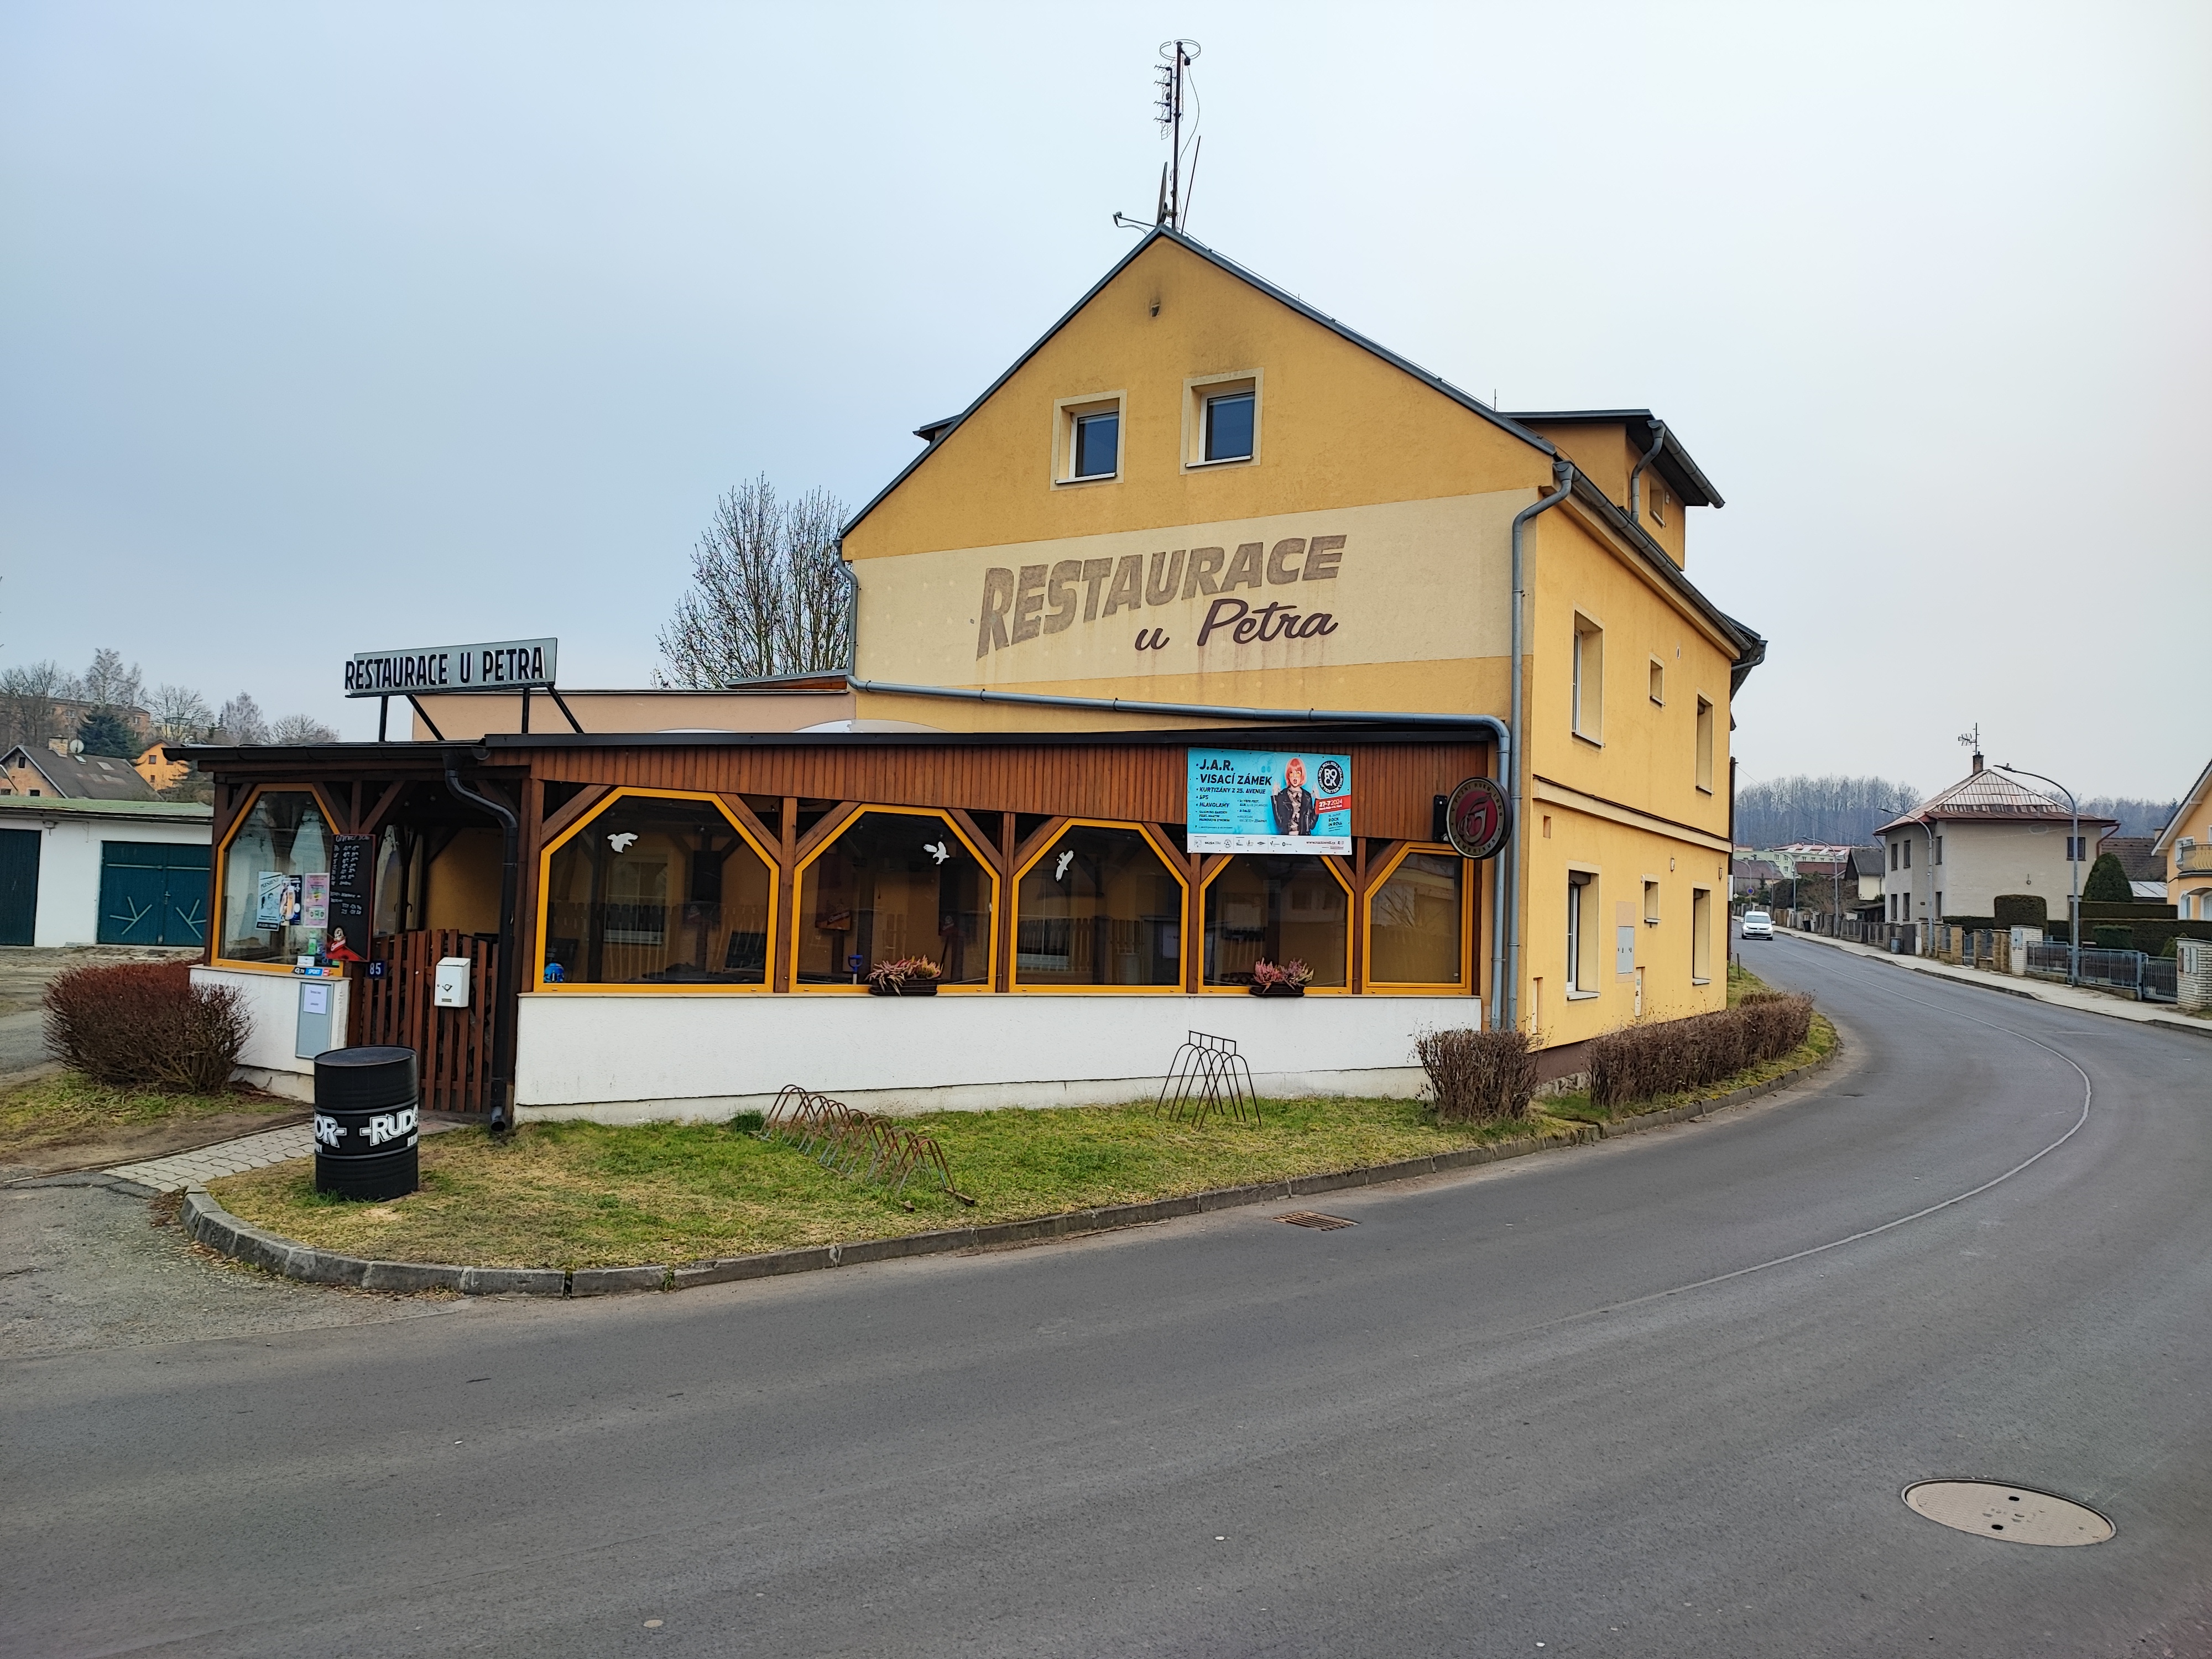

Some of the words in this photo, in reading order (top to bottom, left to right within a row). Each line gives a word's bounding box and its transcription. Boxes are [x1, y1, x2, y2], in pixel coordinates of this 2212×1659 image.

[977, 534, 1347, 661] RESTAURACE
[1134, 627, 1170, 651] u
[1197, 598, 1339, 646] Petra
[345, 654, 450, 690] RESTAURACE
[460, 651, 473, 684] U
[482, 646, 546, 682] PETRA
[1199, 759, 1234, 771] J.A.R.
[1200, 773, 1236, 784] VISACÍ
[1237, 773, 1272, 786] ZÁMEK
[369, 962, 382, 975] 85
